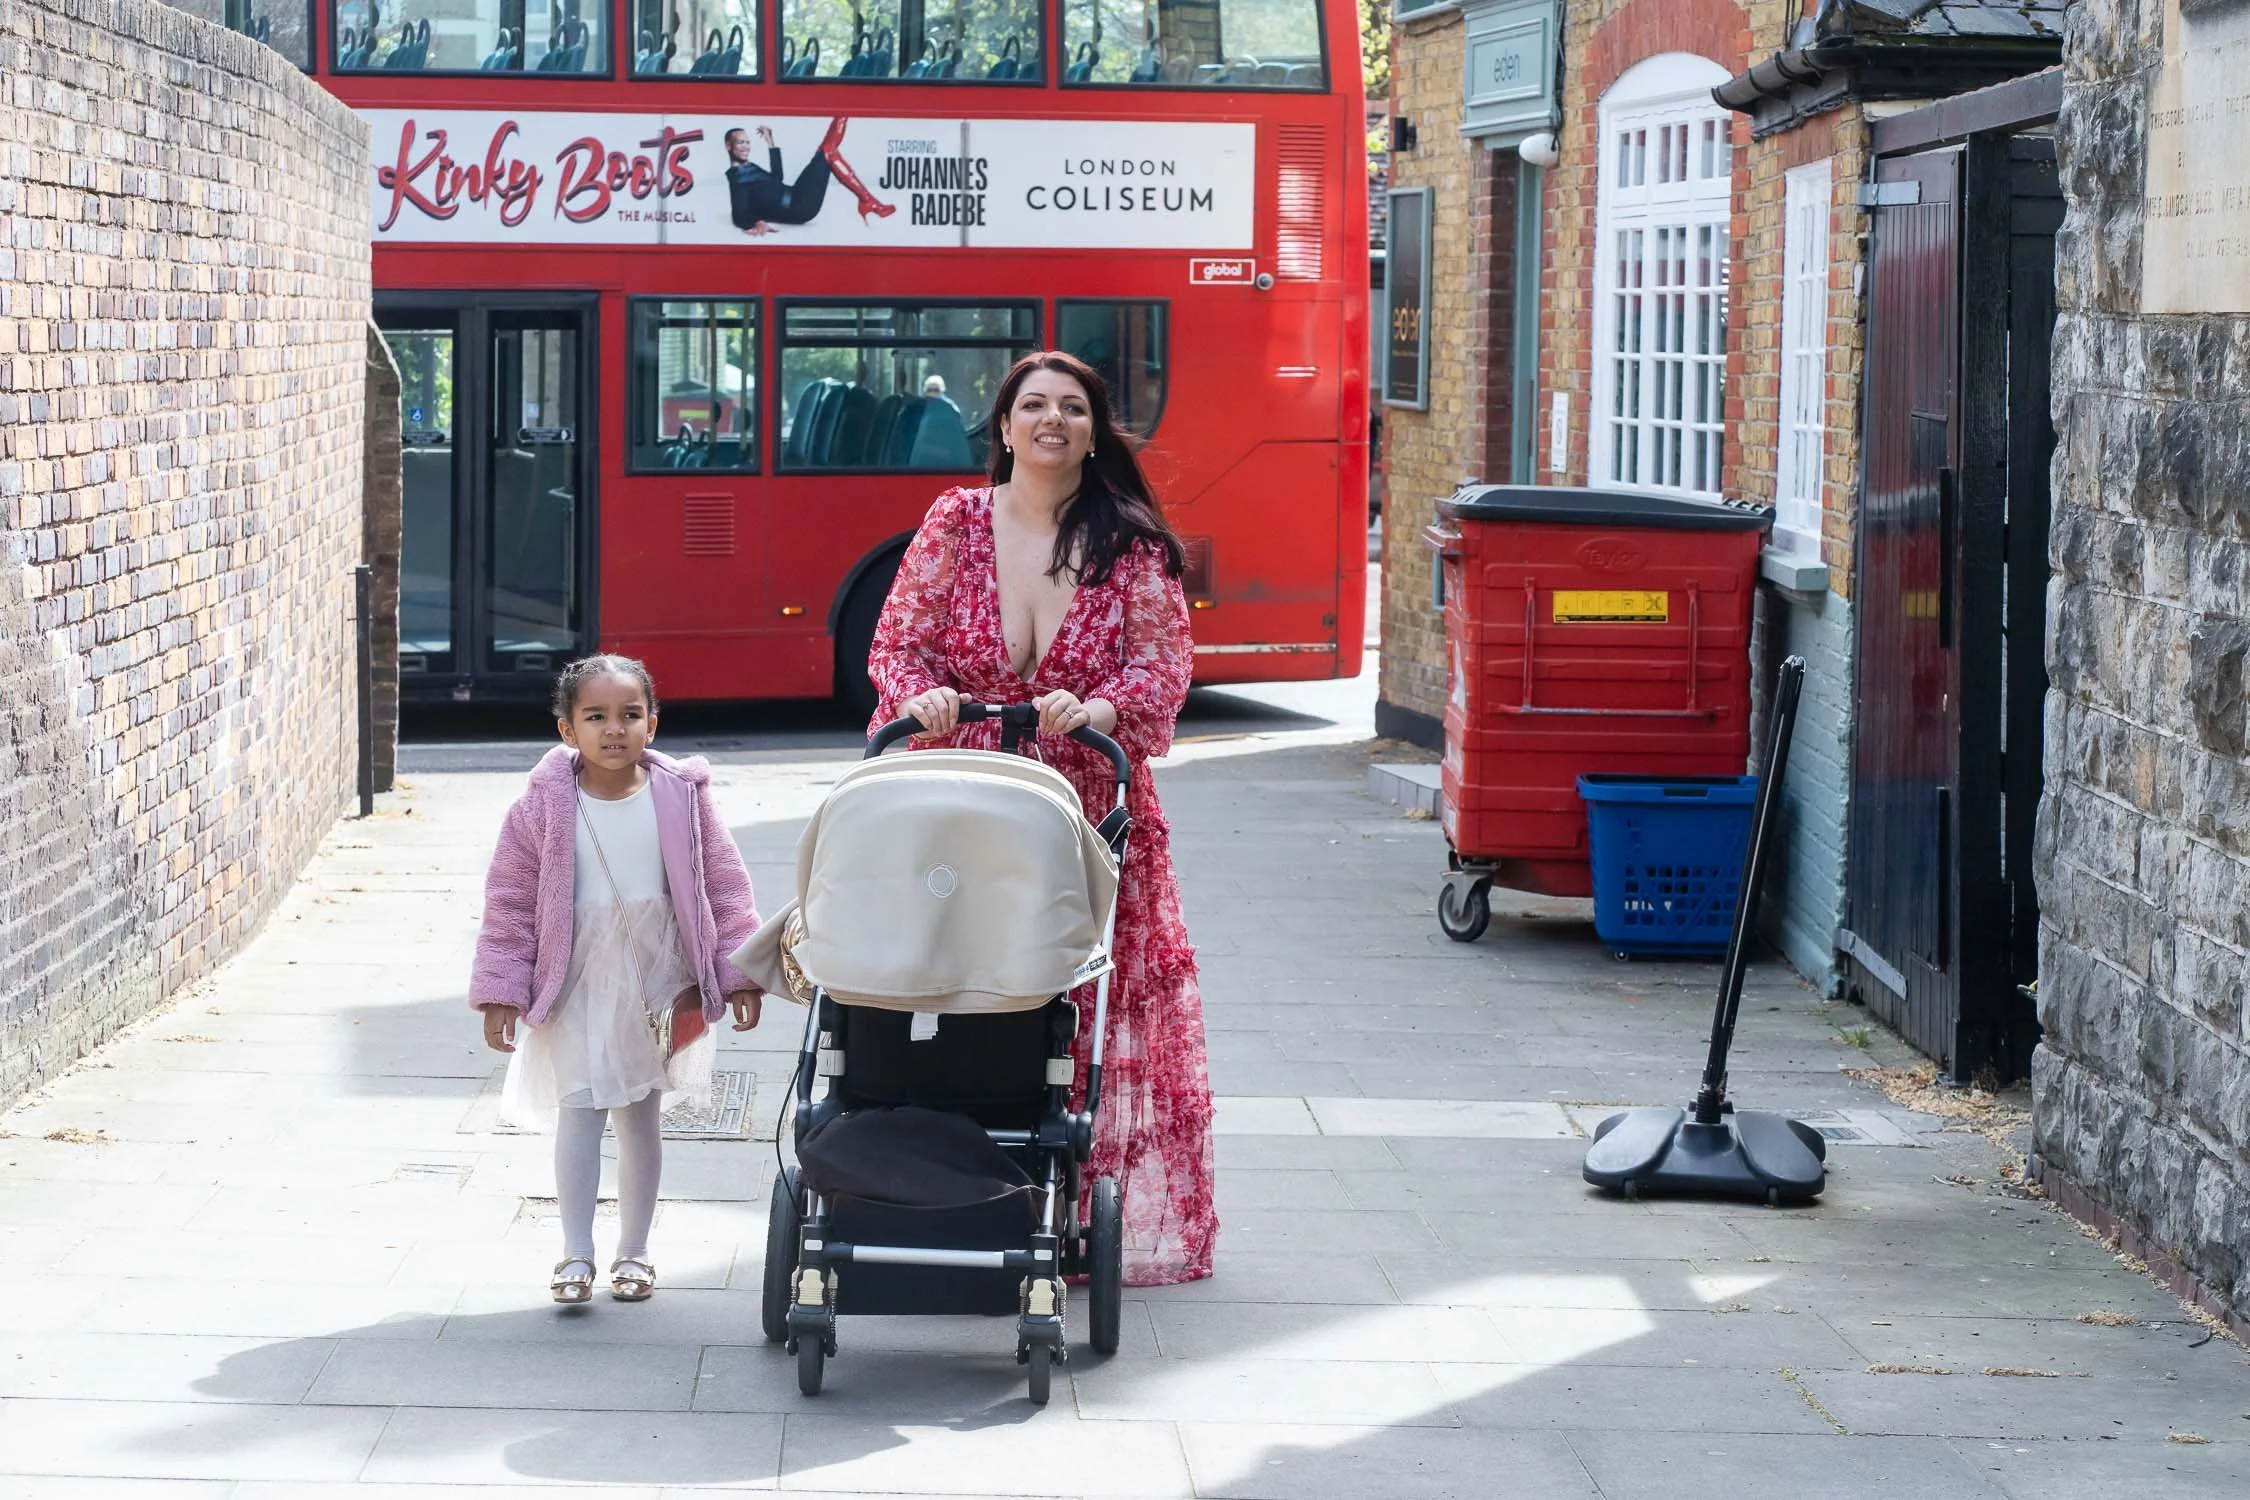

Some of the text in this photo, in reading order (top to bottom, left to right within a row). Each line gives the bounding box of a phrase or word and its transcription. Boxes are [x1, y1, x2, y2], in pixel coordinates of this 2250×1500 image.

[1493, 47, 1520, 82] eden
[887, 139, 937, 154] STARRING
[378, 118, 703, 232] Kinky Boots
[879, 156, 988, 190] JOHANNES
[1065, 159, 1176, 176] LONDON
[912, 193, 986, 226] RADEBE
[1026, 186, 1214, 212] COLISEUM
[618, 210, 696, 223] THE MUSICAL
[1203, 262, 1243, 281] global
